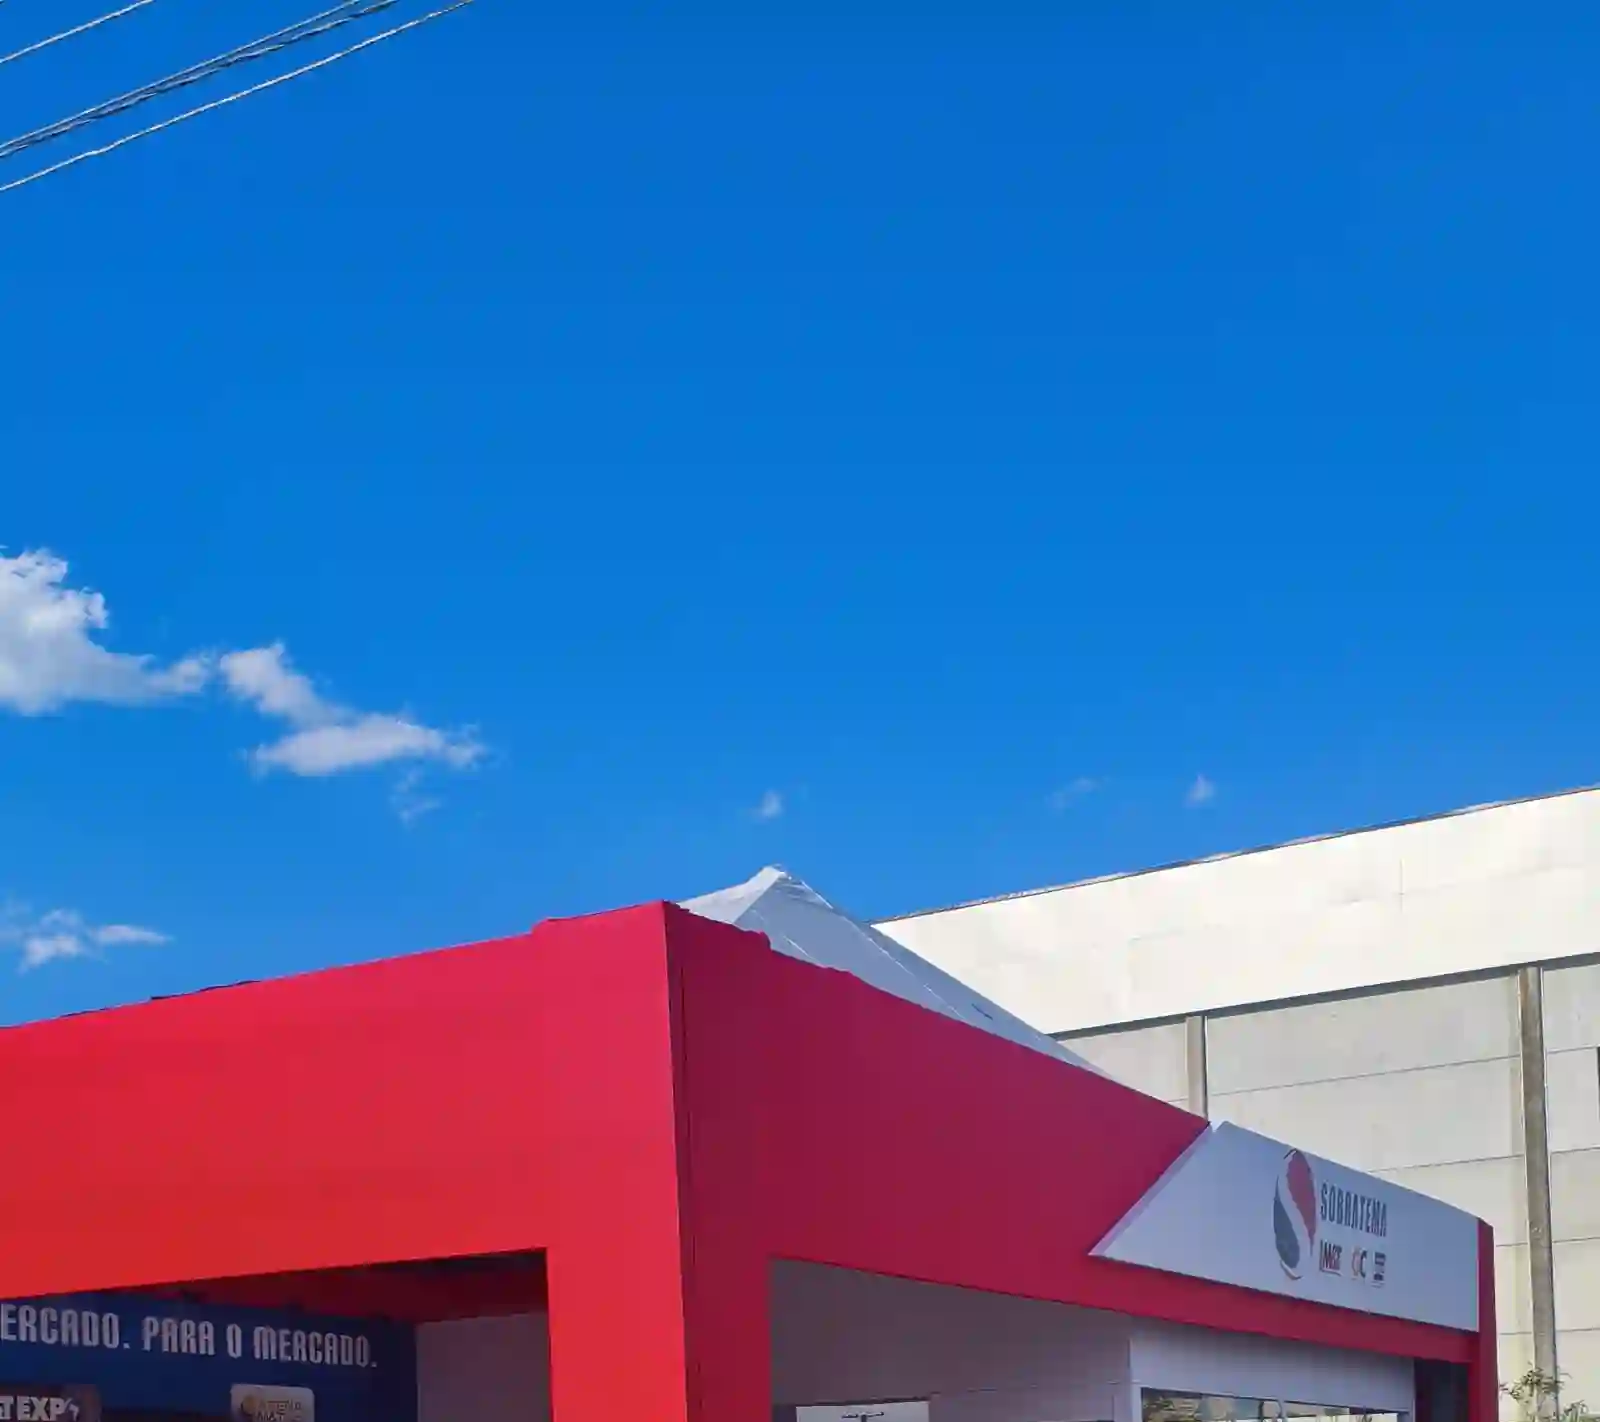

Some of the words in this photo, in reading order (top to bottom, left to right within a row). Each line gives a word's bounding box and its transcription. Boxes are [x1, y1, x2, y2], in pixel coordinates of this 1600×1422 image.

[1320, 1182, 1387, 1238] SOBRATEMA
[142, 1316, 216, 1356] PARA
[226, 1323, 243, 1358] O
[253, 1325, 378, 1368] MERCADO.
